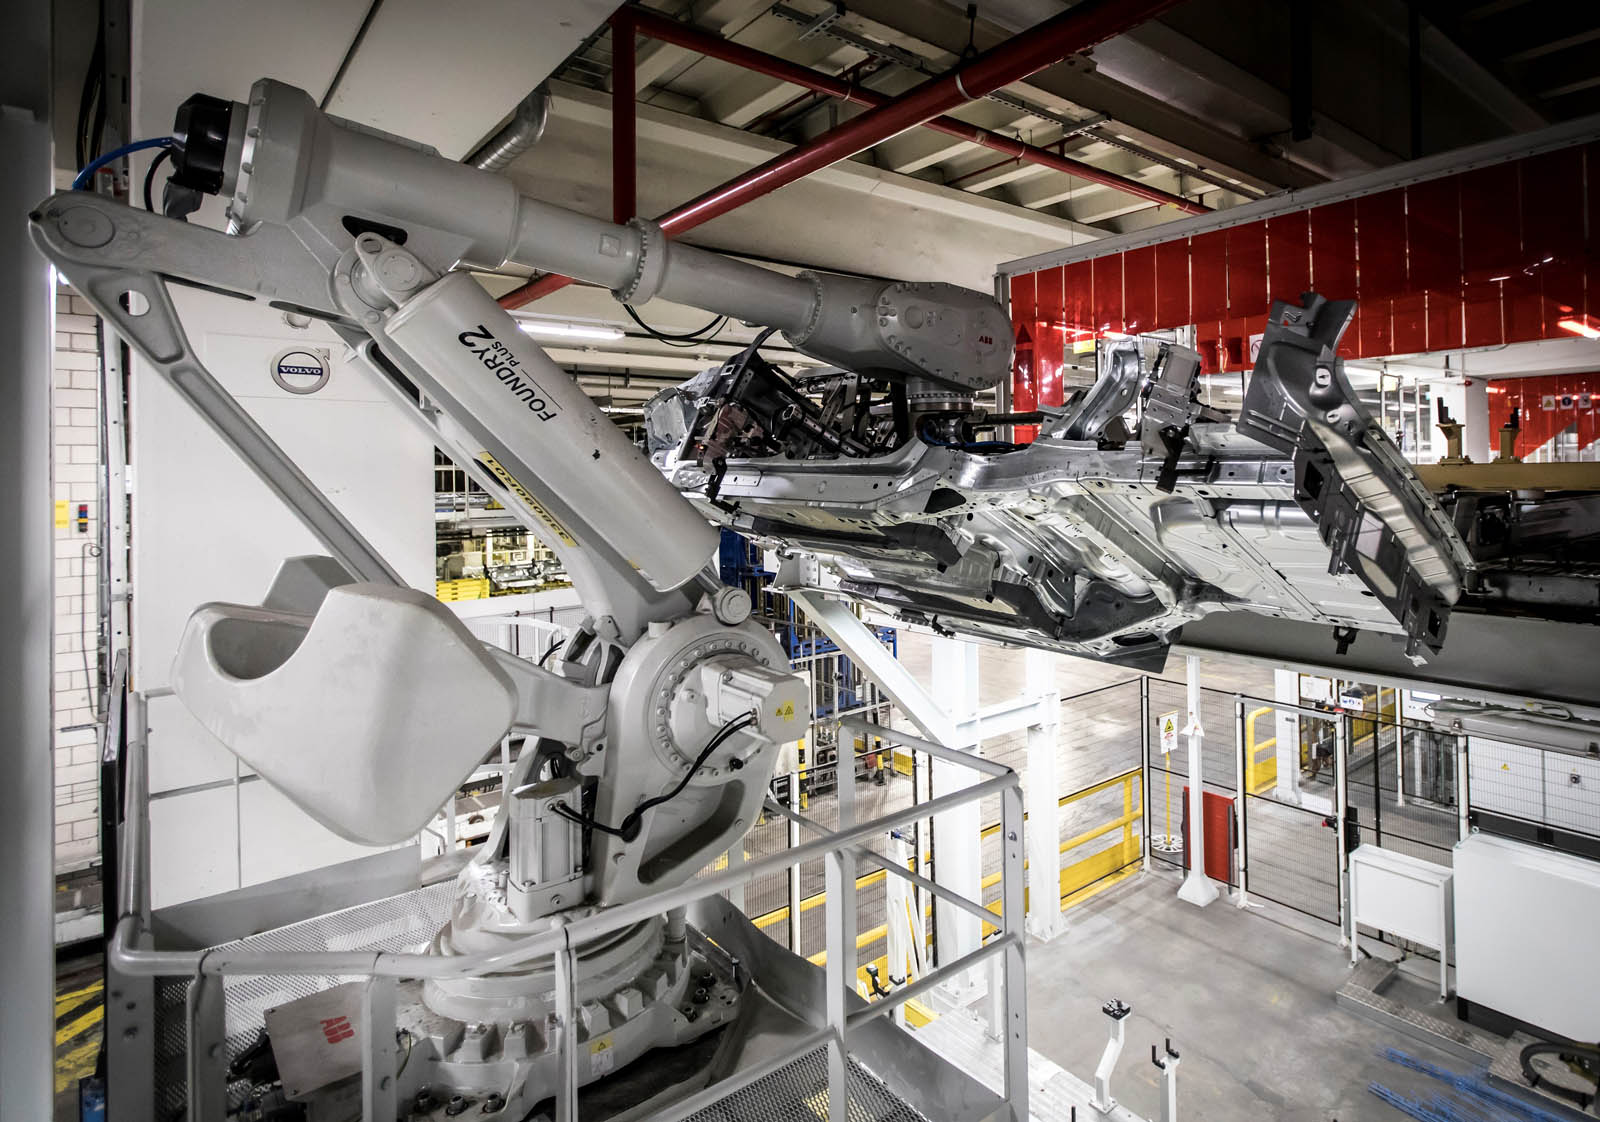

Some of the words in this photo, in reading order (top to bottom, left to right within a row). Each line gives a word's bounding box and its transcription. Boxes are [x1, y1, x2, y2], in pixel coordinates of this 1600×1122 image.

[458, 324, 496, 347] 2
[978, 335, 993, 345] ABB
[491, 341, 521, 367] PLUS
[279, 366, 321, 375] VOLVO
[471, 347, 557, 422] FOUNDRY
[320, 1015, 355, 1044] ABB
